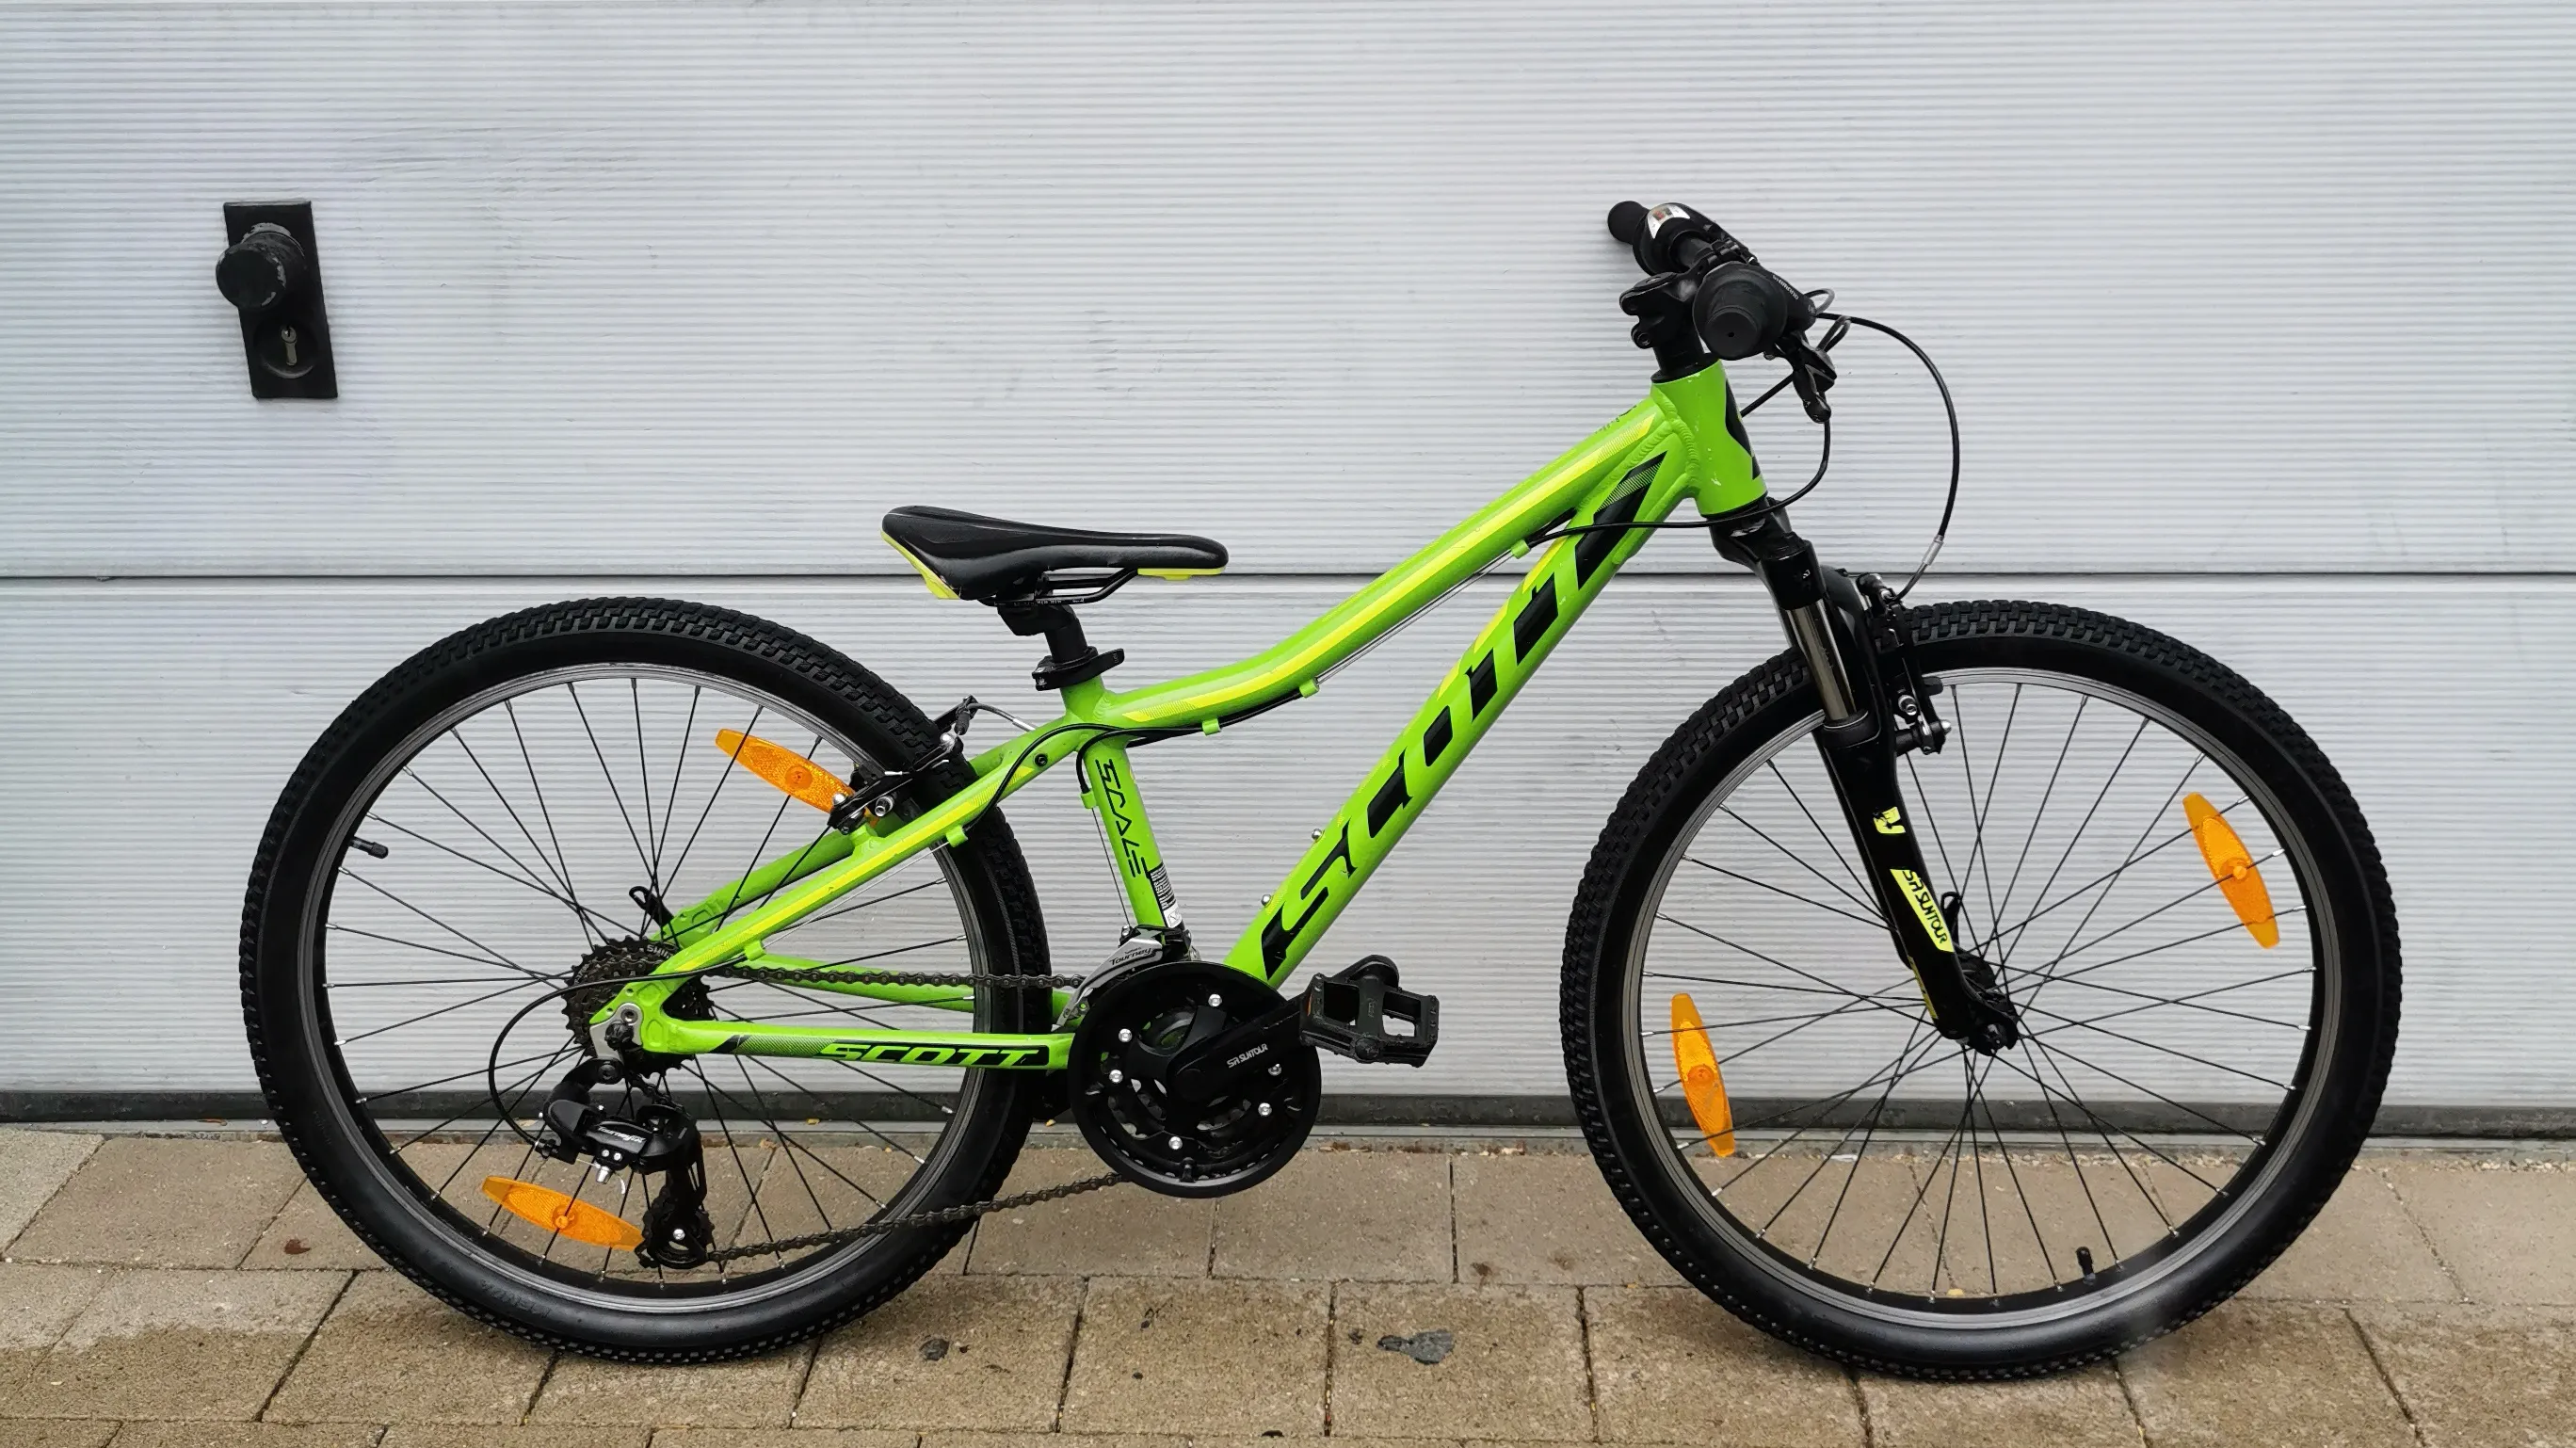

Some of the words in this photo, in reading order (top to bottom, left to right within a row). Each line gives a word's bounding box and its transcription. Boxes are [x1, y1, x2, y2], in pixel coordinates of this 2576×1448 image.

[1261, 499, 1612, 979] SCOTT
[1095, 759, 1149, 878] SCALE
[1914, 891, 1948, 944] SUNTOUR
[1109, 947, 1151, 966] Tourney
[818, 1042, 1039, 1067] SCOTT
[1226, 1056, 1241, 1069] SR
[1238, 1043, 1269, 1062] SUNTOUR
